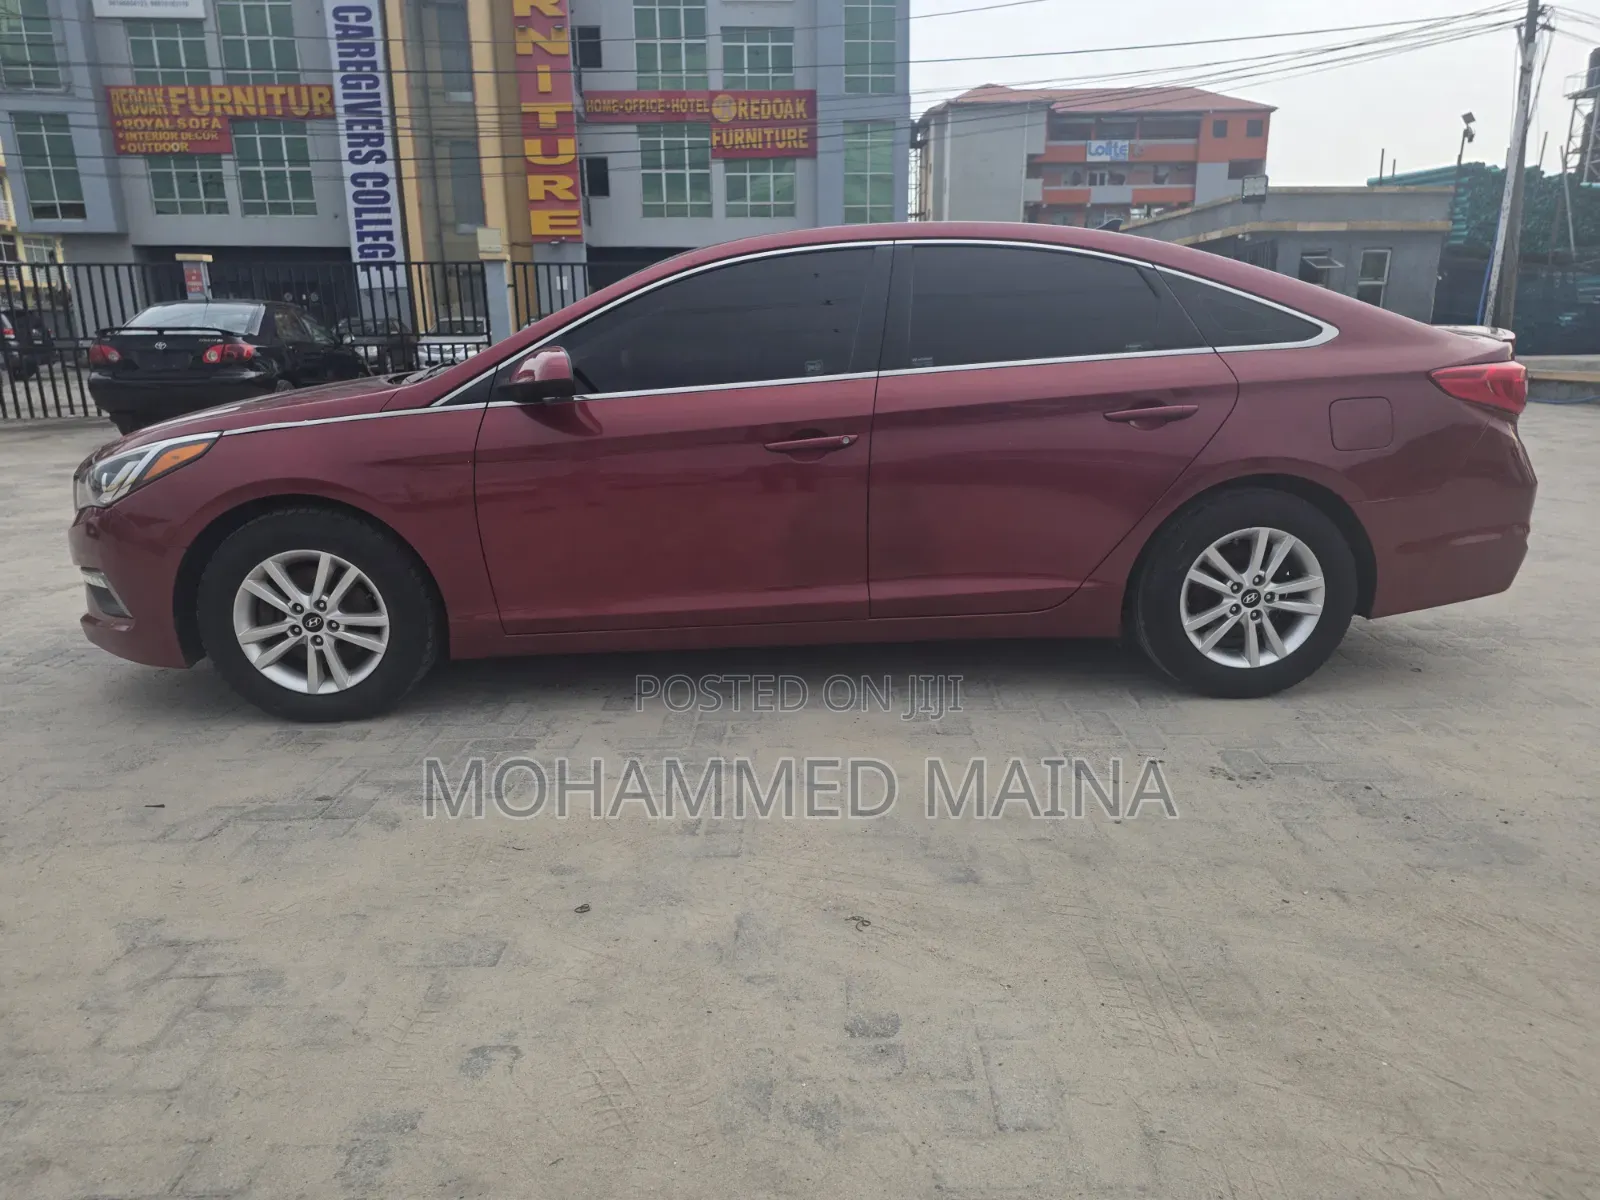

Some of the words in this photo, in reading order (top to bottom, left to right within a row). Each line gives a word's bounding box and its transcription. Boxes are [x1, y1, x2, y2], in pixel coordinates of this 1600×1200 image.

[332, 5, 387, 166] CAREGIVERS
[176, 117, 222, 129] SOFA
[712, 127, 809, 150] FURNITURE
